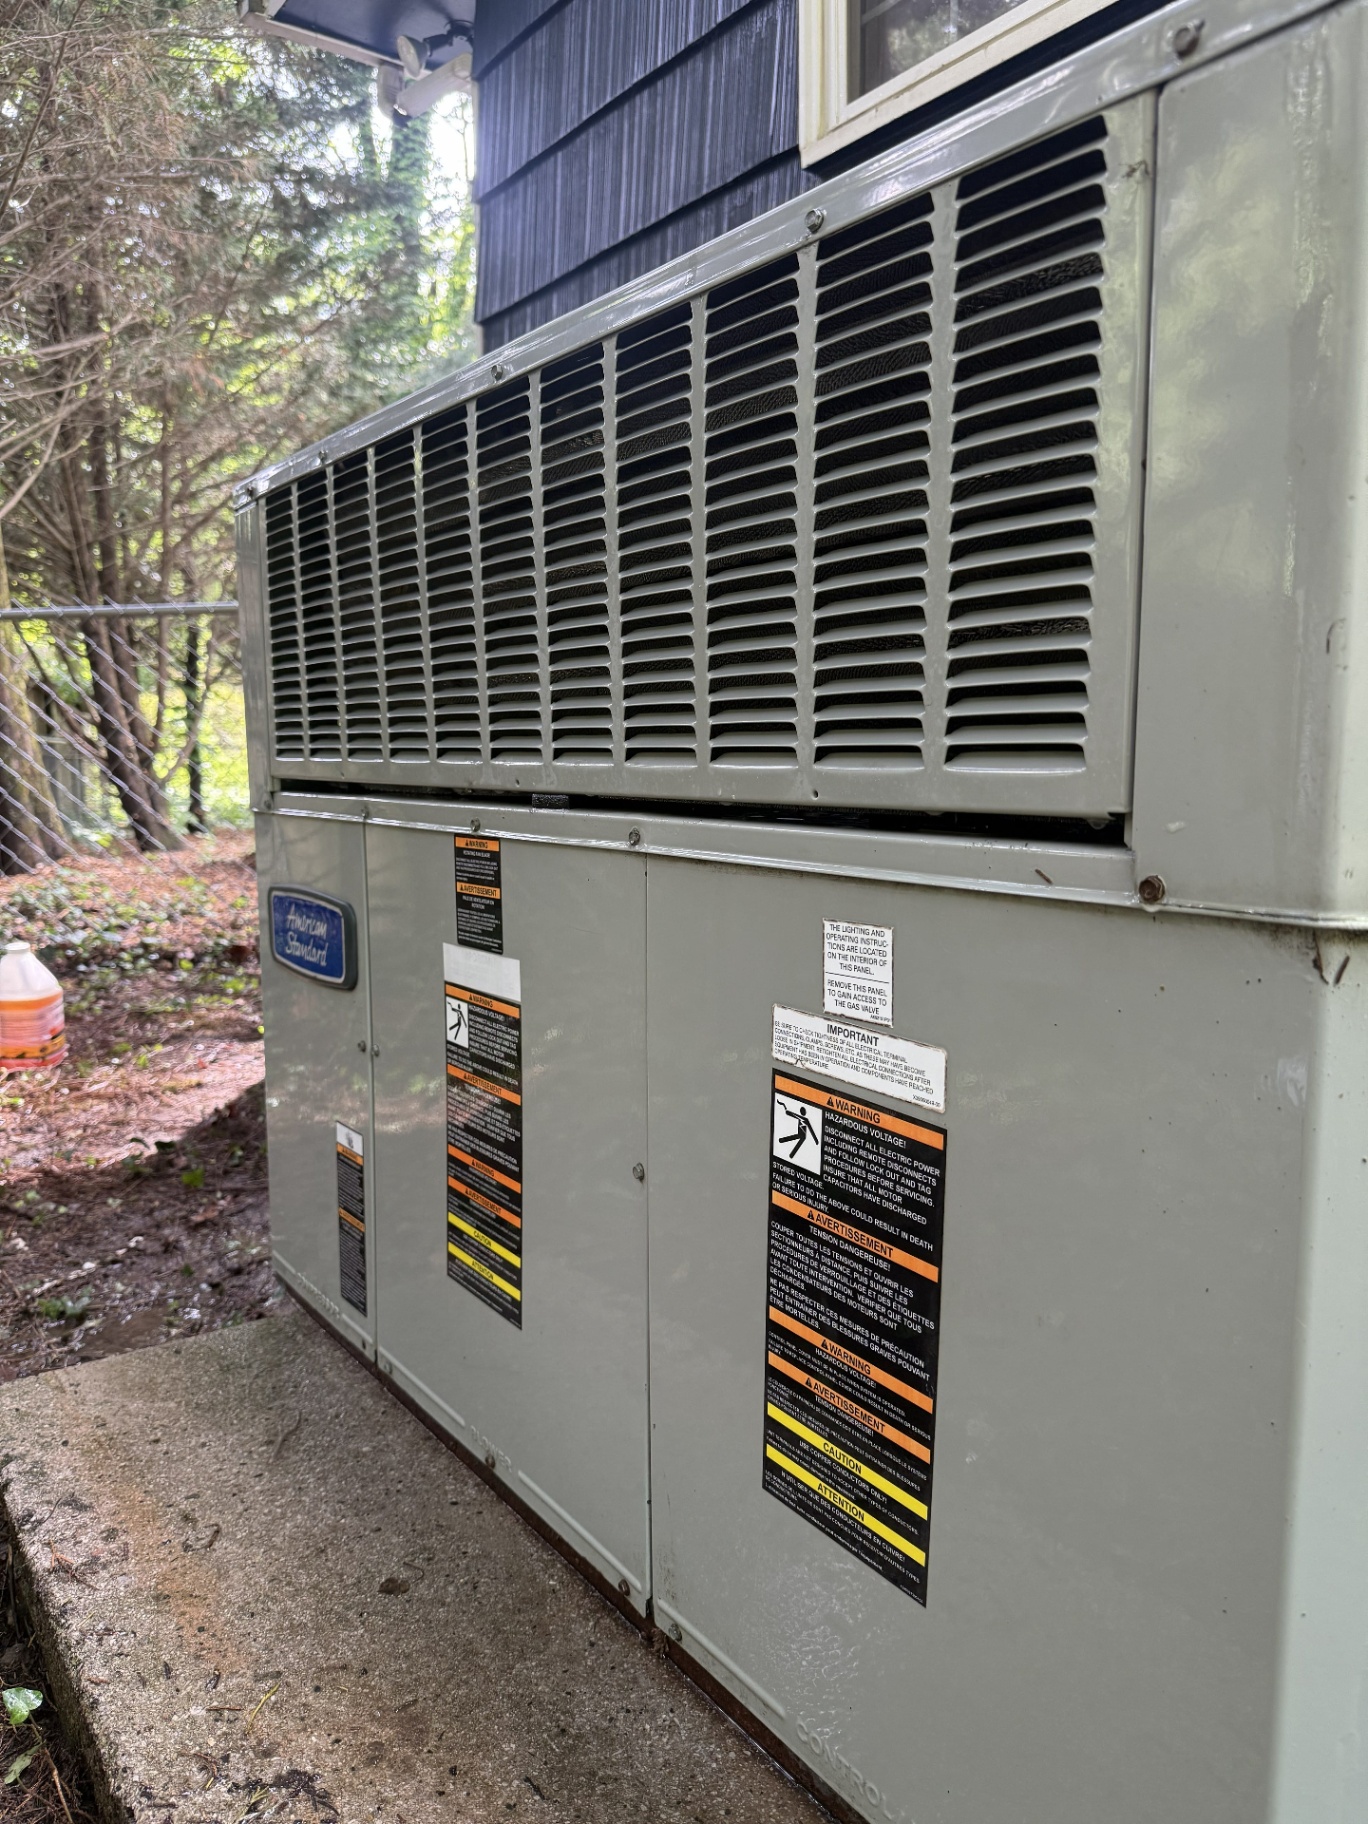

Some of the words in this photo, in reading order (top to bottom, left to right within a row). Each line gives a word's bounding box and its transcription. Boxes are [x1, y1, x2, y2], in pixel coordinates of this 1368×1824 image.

[469, 840, 488, 849] WARNING
[463, 884, 497, 897] AVERTISSEMENT
[286, 903, 327, 940] American
[826, 932, 858, 943] OPERATING
[860, 937, 888, 947] INSTRUC-
[829, 923, 840, 931] THE
[842, 925, 869, 935] LIGHTING
[870, 929, 884, 938] AND
[285, 931, 328, 967] Standard
[827, 941, 844, 951] TIONS
[846, 944, 857, 953] ARE
[859, 946, 886, 957] LOCATED
[827, 951, 836, 959] ON
[837, 952, 847, 960] THE
[850, 954, 877, 965] INTERIOR
[878, 958, 886, 966] OF
[839, 962, 852, 971] THIS
[853, 964, 874, 975] PANEL.
[827, 978, 851, 990] REMOVE
[853, 983, 866, 993] THIS
[867, 986, 887, 997] PANEL
[827, 988, 835, 996] TO
[837, 990, 851, 999] GAIN
[852, 993, 876, 1004] ACCESS
[878, 997, 886, 1006] TO
[834, 998, 845, 1007] THE
[847, 1001, 859, 1010] GAS
[861, 1004, 879, 1014] VALVE
[827, 1023, 878, 1046] IMPORTANT
[467, 1074, 502, 1095] AVERTISSEMENT
[849, 1055, 877, 1070] ELECTRICAL
[878, 1064, 913, 1080] CONNECTIONS
[914, 1075, 930, 1086] AFTER
[825, 1110, 868, 1134] HAZARDOUS
[869, 1127, 906, 1149] VOLTAGE!
[835, 1098, 880, 1124] WARNING
[824, 1125, 863, 1147] DISCONNECT
[865, 1140, 877, 1152] ALL
[879, 1146, 912, 1166] ELECTRIC
[913, 1159, 940, 1177] POWER
[824, 1134, 857, 1154] INCLUDING
[859, 1148, 885, 1166] REMOTE
[887, 1159, 936, 1187] DISCONNECTS
[824, 1144, 837, 1156] AND
[838, 1150, 864, 1167] FOLLOW
[866, 1161, 883, 1175] LOCK
[885, 1169, 899, 1182] OUT
[900, 1175, 915, 1188] AND
[917, 1182, 931, 1195] TAG
[772, 1160, 795, 1177] STORED
[796, 1170, 824, 1190] VOLTAGE.
[823, 1154, 866, 1178] PROCEDURES
[867, 1172, 893, 1190] BEFORE
[895, 1183, 934, 1208] SERVICING.
[823, 1163, 846, 1180] INSURE
[847, 1173, 863, 1187] THAT
[864, 1181, 876, 1193] ALL
[878, 1187, 902, 1204] MOTOR
[772, 1181, 780, 1191] OR
[781, 1185, 806, 1203] SERIOUS
[807, 1196, 829, 1213] INJURY.
[772, 1171, 795, 1188] FAILURE
[796, 1182, 804, 1193] TO
[805, 1186, 814, 1197] DO
[815, 1191, 827, 1203] THE
[828, 1196, 849, 1213] ABOVE
[850, 1206, 873, 1224] COULD
[874, 1217, 899, 1236] RESULT
[900, 1229, 907, 1240] IN
[909, 1233, 933, 1252] DEATH
[823, 1173, 862, 1197] CAPACITORS
[863, 1190, 880, 1205] HAVE
[882, 1198, 926, 1226] DISCHARGED
[473, 1230, 492, 1247] CAUTION
[808, 1224, 837, 1246] TENSION
[839, 1238, 890, 1272] DANGEREUSE!
[815, 1212, 893, 1258] AVERTISSEMENT
[472, 1260, 494, 1281] ATTENTION
[770, 1219, 794, 1237] COUPER
[795, 1232, 818, 1249] TOUTES
[819, 1244, 831, 1256] LES
[831, 1250, 863, 1272] TENSIONS
[864, 1266, 872, 1277] ET
[873, 1270, 898, 1290] OUVRIR
[900, 1284, 913, 1297] LES
[770, 1228, 814, 1258] SECTIONNEURS
[821, 1254, 852, 1277] DISTANCE,
[853, 1270, 868, 1285] PUIS
[869, 1279, 893, 1298] SUIVRE
[894, 1291, 908, 1305] LES
[769, 1256, 780, 1268] LES
[833, 1290, 845, 1303] DES
[847, 1297, 878, 1320] MOTEURS
[879, 1314, 897, 1330] SONT
[770, 1247, 788, 1263] AVANT
[789, 1257, 808, 1273] TOUTE
[808, 1267, 853, 1298] INTERVENTION.
[887, 1308, 901, 1323] QUE
[903, 1316, 922, 1334] TOUS
[810, 1258, 818, 1269] DE
[819, 1263, 867, 1294] VERROUILLAGE
[867, 1288, 876, 1299] ET
[877, 1293, 890, 1307] DES
[892, 1299, 935, 1330] ÉTIQUETTES
[769, 1276, 777, 1287] NE
[778, 1281, 789, 1293] PAS
[790, 1287, 824, 1313] RESPECTER
[826, 1307, 838, 1320] CES
[839, 1314, 869, 1338] MESURES
[870, 1331, 879, 1343] DE
[881, 1335, 924, 1368] PRÉCAUTION
[769, 1285, 783, 1300] PEUT
[818, 1313, 830, 1326] DES
[831, 1320, 868, 1347] BLESSURES
[869, 1341, 896, 1363] GRAVES
[897, 1357, 929, 1381] POUVANT
[785, 1303, 820, 1329] MORTELLES.
[815, 1347, 848, 1372] HAZARDOUS
[848, 1366, 876, 1389] VOLTAGE!
[828, 1342, 870, 1375] WARNING
[813, 1381, 885, 1434] AVERTISSEMENT
[799, 1439, 809, 1451] USE
[809, 1446, 831, 1466] COPPER
[832, 1461, 870, 1492] CONDUCTORS
[823, 1441, 861, 1474] CAUTION
[817, 1481, 864, 1522] ATTENTION
[820, 1497, 830, 1510] DES
[831, 1504, 872, 1540] CONDUCTEURS
[872, 1534, 880, 1546] EN
